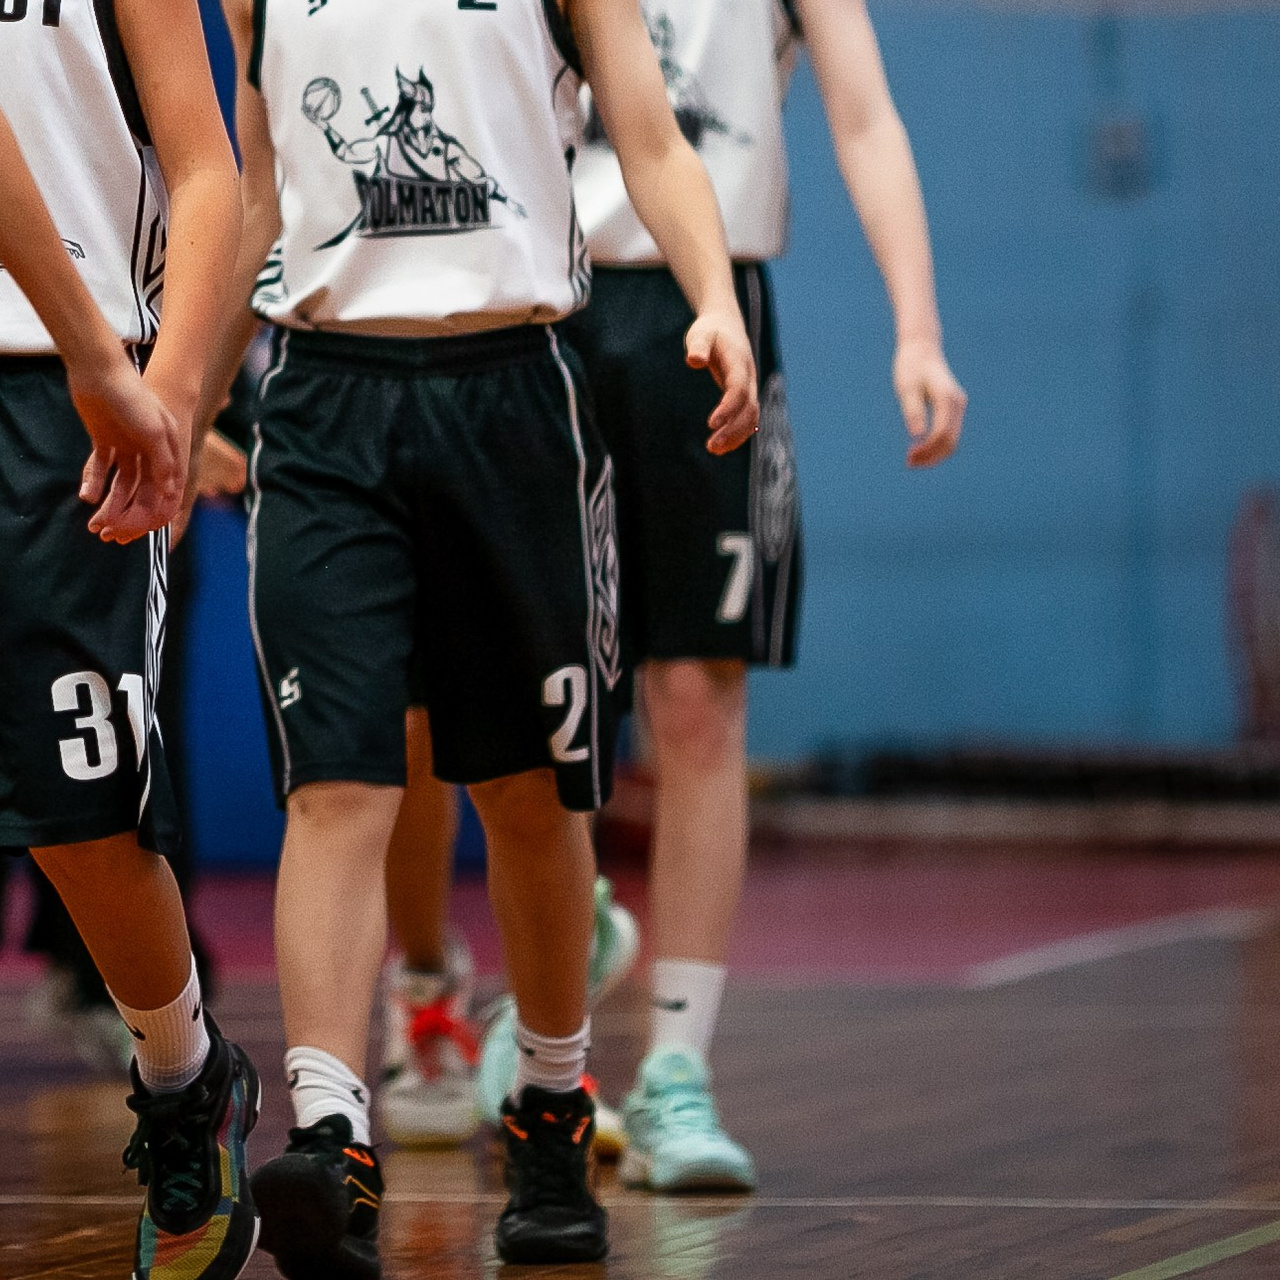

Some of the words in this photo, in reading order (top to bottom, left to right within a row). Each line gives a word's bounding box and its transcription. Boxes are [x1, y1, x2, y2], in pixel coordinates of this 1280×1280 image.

[717, 533, 754, 622] 7
[51, 671, 146, 780] 31
[542, 665, 589, 762] 2
